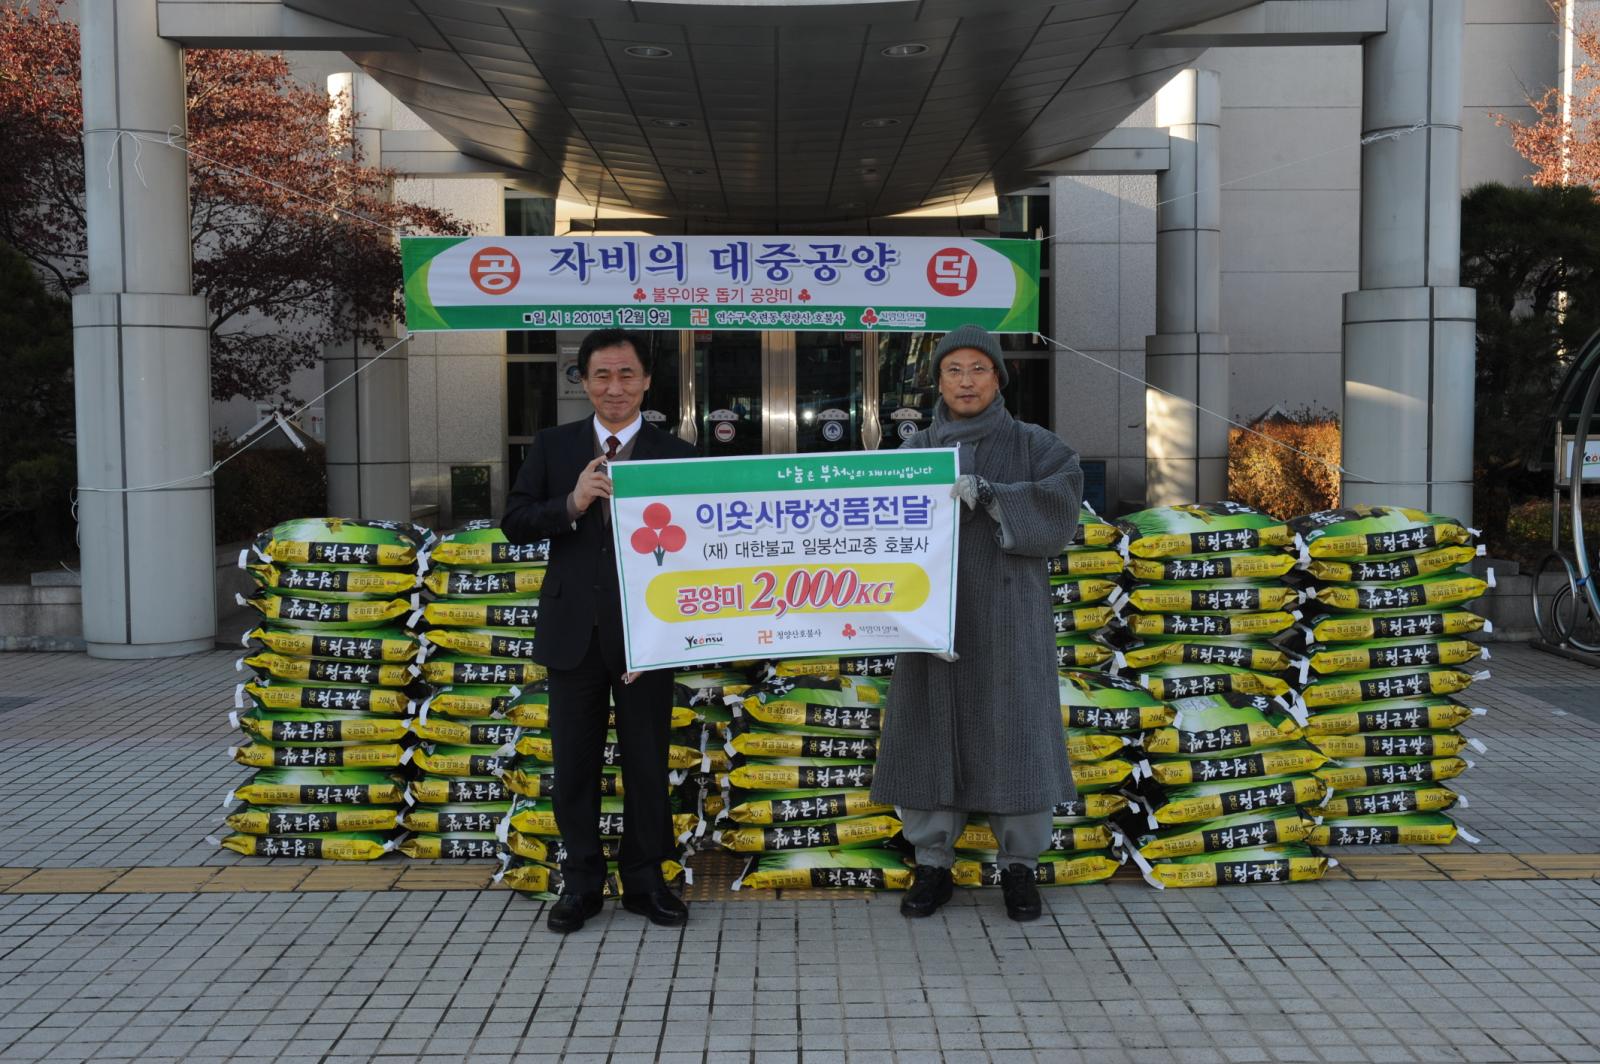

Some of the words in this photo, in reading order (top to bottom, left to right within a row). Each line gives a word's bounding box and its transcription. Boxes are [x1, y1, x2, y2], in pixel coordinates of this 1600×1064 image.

[478, 254, 514, 290] 공
[549, 241, 686, 283] 자비의
[709, 241, 898, 284] 대중공양
[935, 255, 970, 291] 덕
[652, 287, 710, 304] 불우이웃
[716, 288, 744, 304] 돕기
[750, 288, 792, 304] 공양미
[574, 311, 612, 324] 2010년
[618, 309, 644, 325] 12월
[648, 309, 670, 324] 9일
[716, 311, 744, 325] 연수구
[749, 311, 780, 325] 옥련동
[814, 312, 845, 326] 호불사
[696, 494, 932, 532] 이웃사랑성품전달
[703, 543, 728, 560] (재)
[736, 539, 794, 558] 대한불교
[802, 536, 878, 556] 일붕선교종
[884, 536, 929, 554] 호불사
[677, 584, 743, 616] 공양미
[684, 634, 723, 649] Yeonsu
